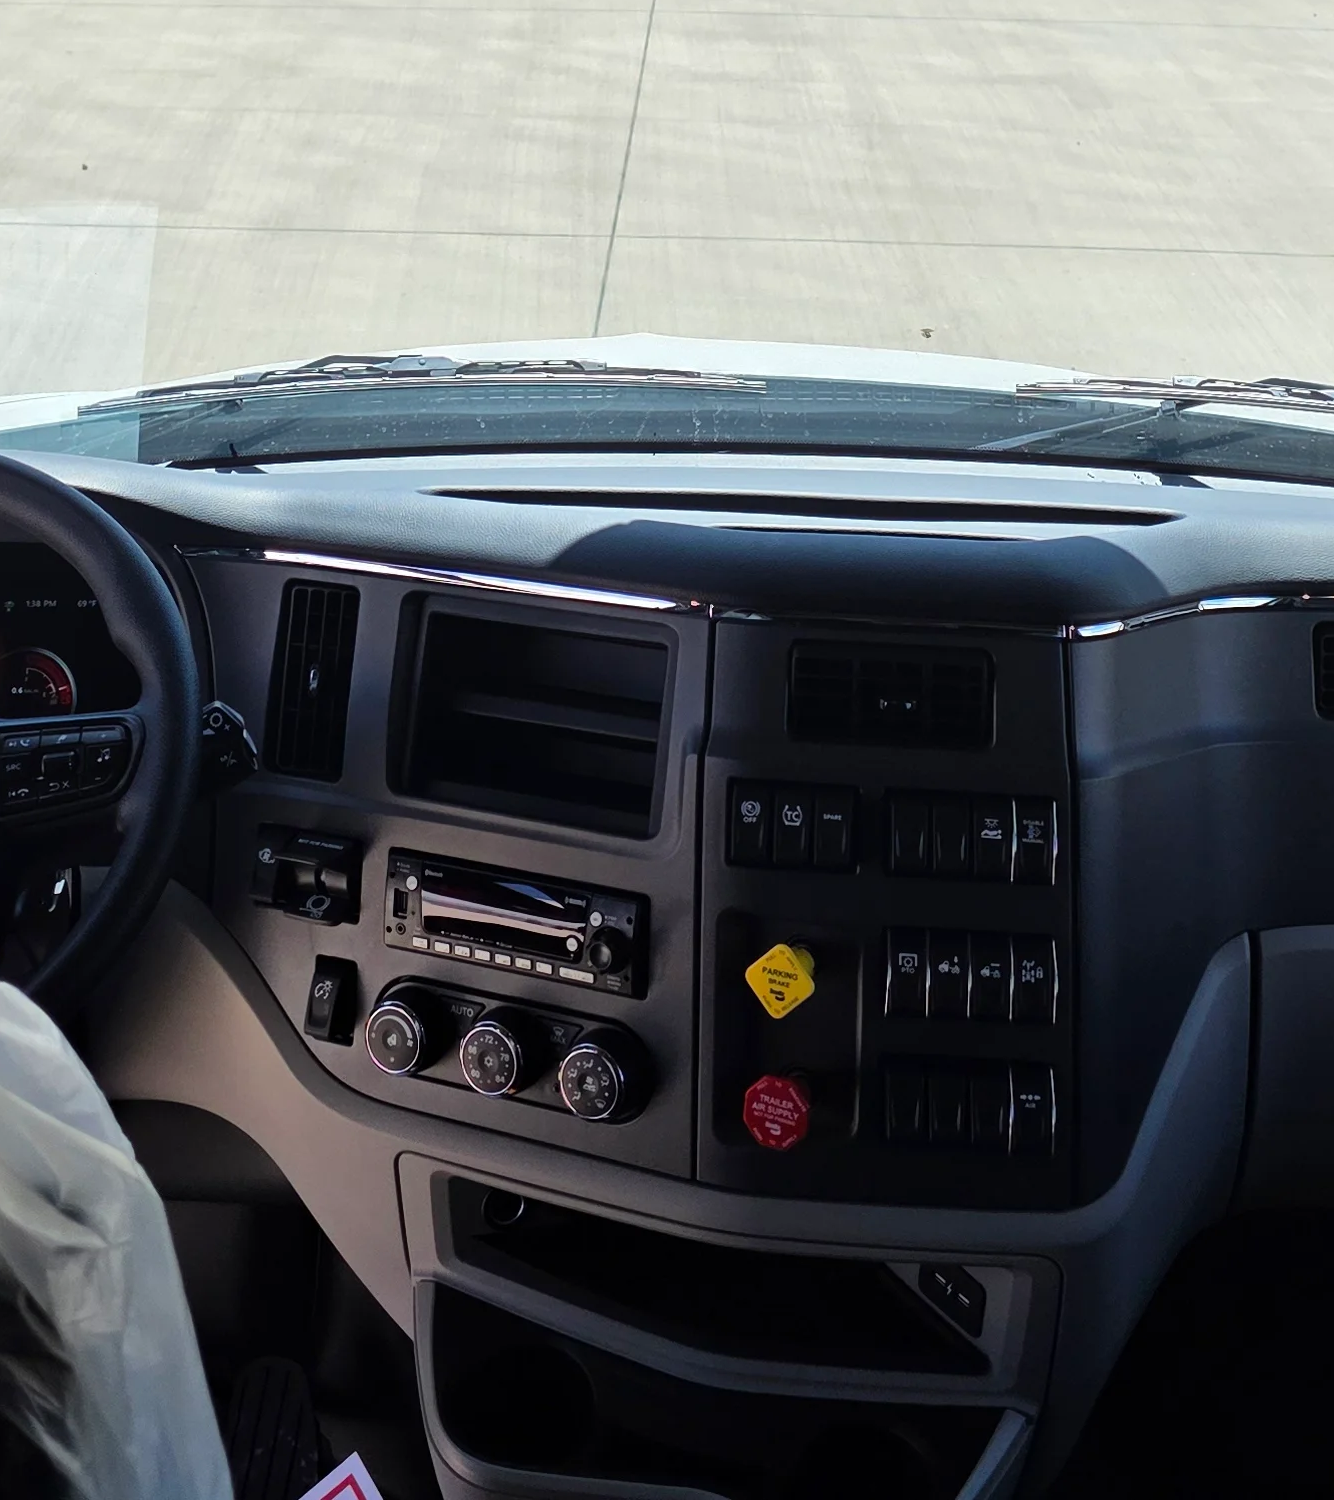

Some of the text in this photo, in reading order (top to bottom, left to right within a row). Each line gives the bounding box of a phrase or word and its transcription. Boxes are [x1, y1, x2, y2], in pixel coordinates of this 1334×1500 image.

[43, 600, 57, 608] PM
[11, 686, 24, 695] 0.6
[742, 816, 758, 824] OFF
[786, 810, 800, 821] TC
[822, 813, 843, 821] SPARE
[761, 966, 798, 981] PARKING
[768, 977, 791, 988] BRAKE
[450, 1004, 474, 1018] AUTO
[484, 1034, 494, 1045] 72
[759, 1093, 794, 1110] TRAILER
[751, 1101, 800, 1121] AIR SUPPLY
